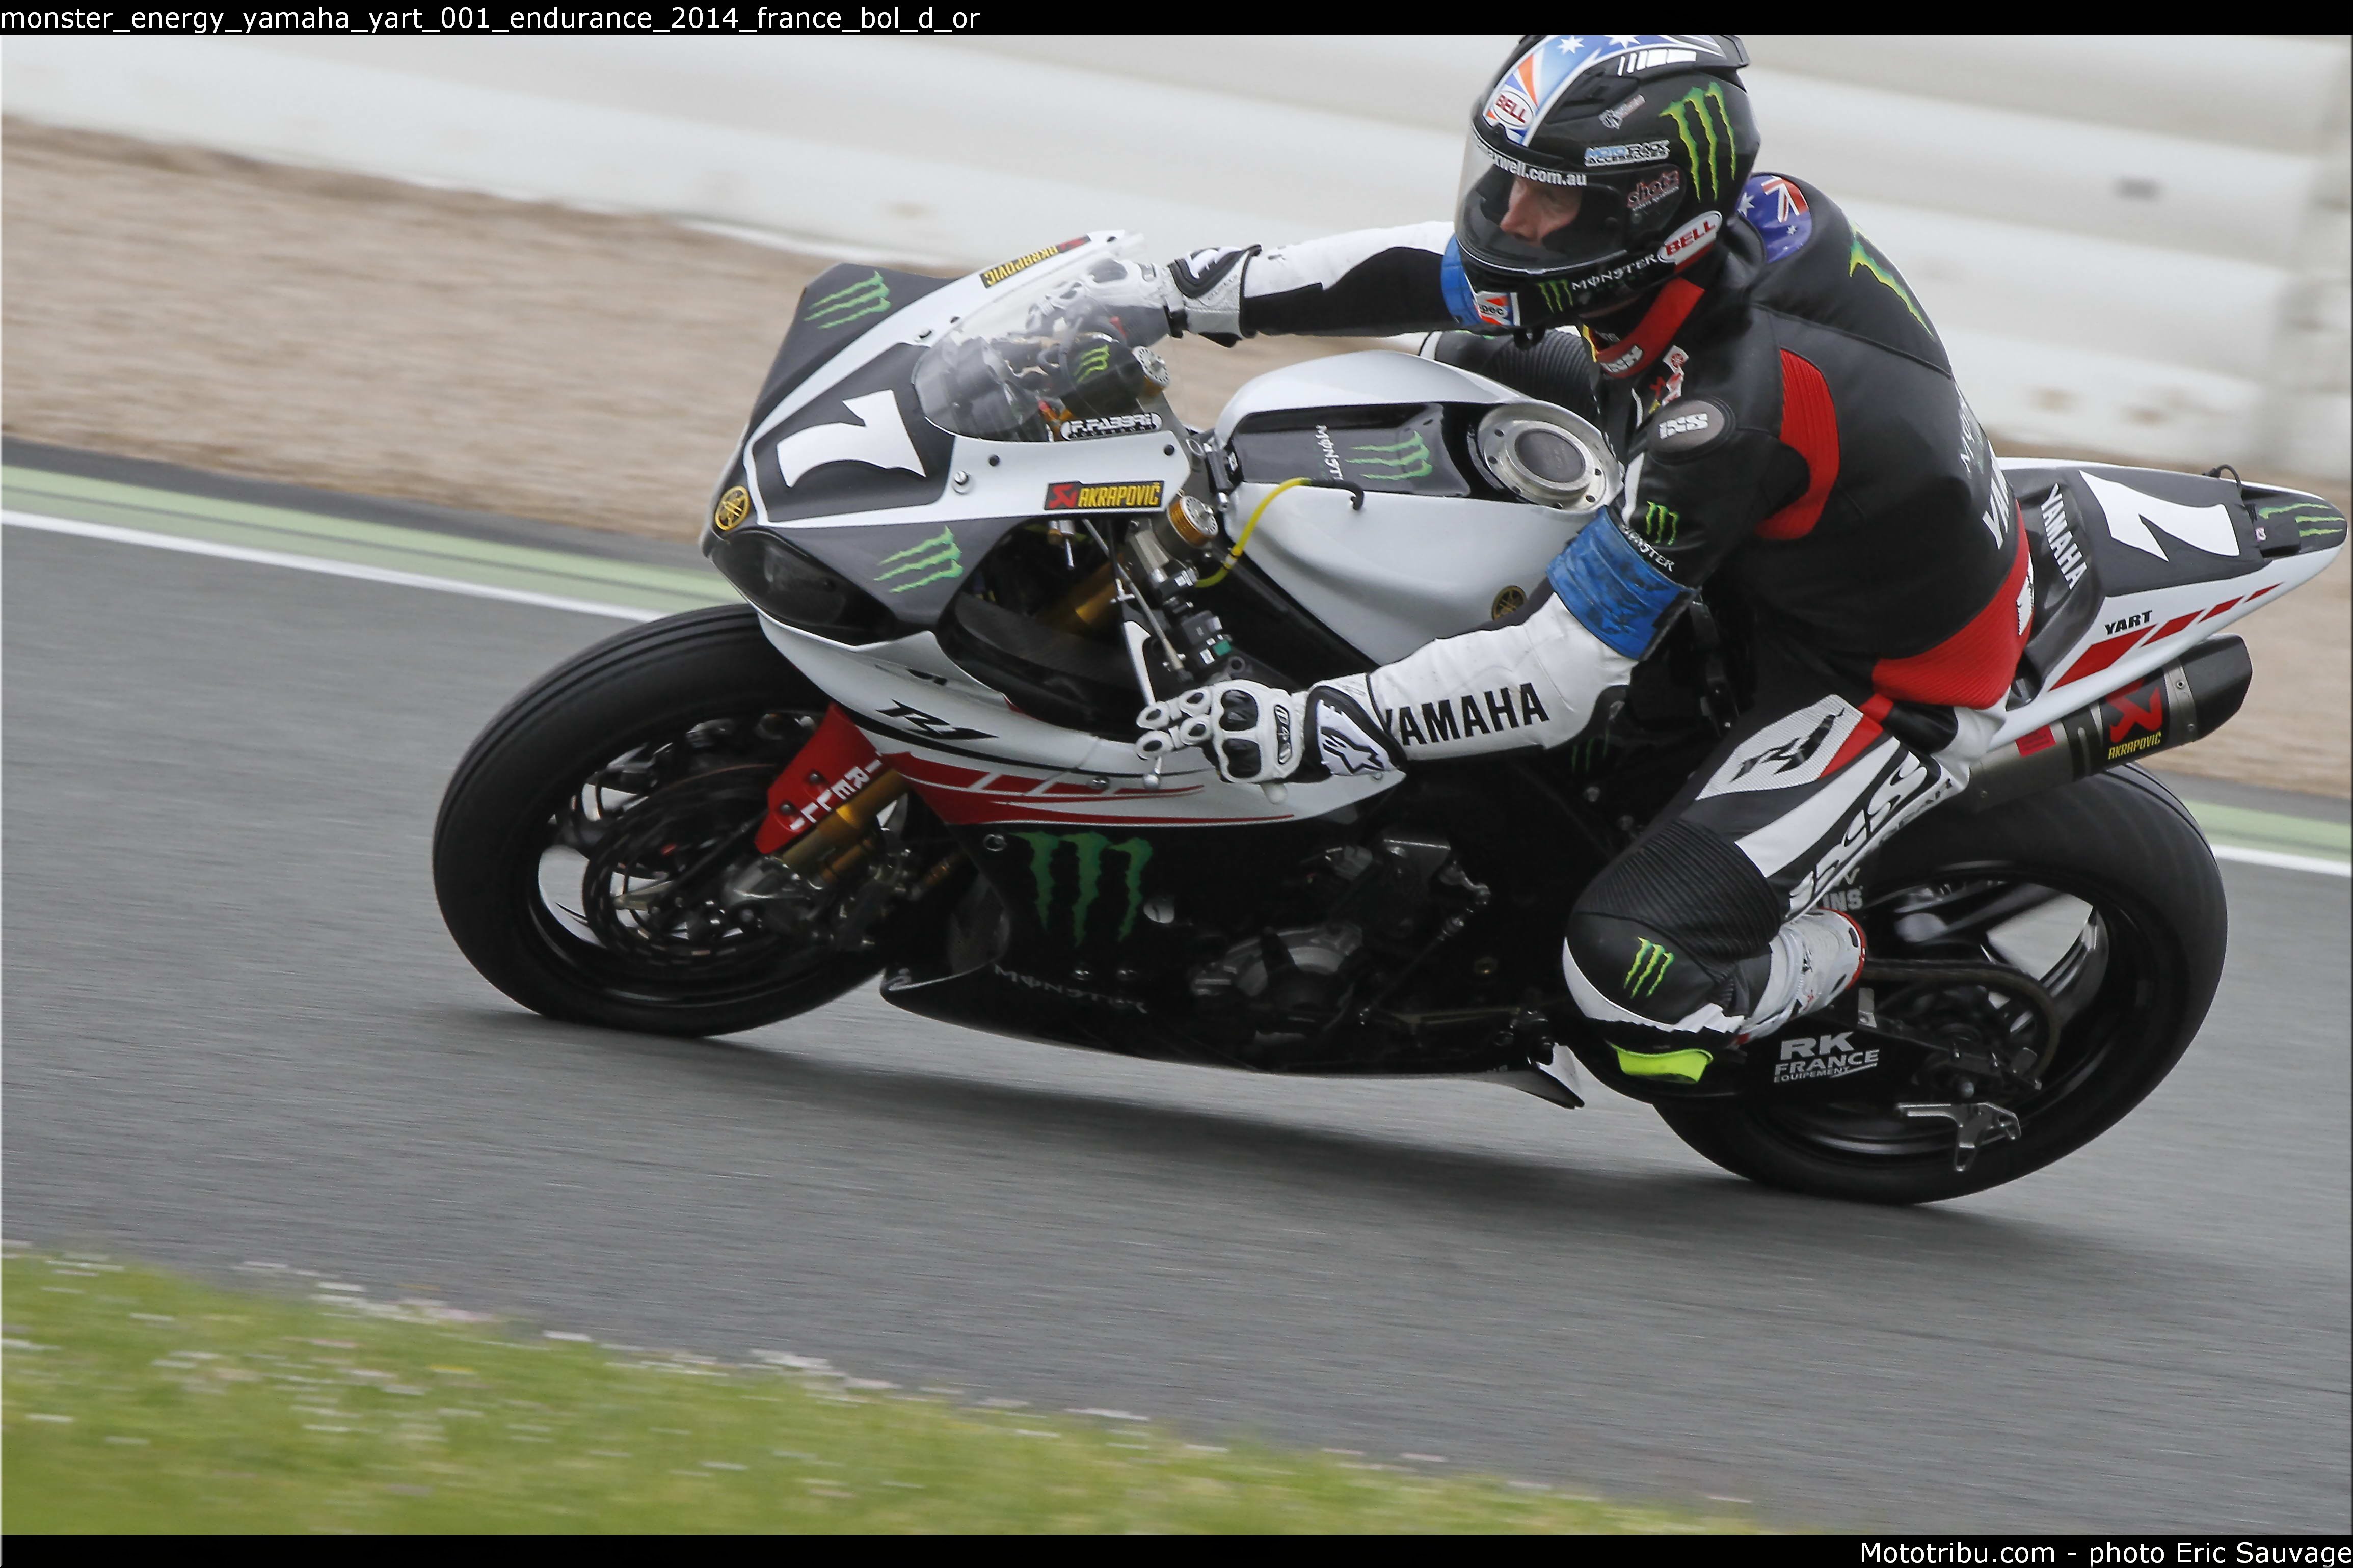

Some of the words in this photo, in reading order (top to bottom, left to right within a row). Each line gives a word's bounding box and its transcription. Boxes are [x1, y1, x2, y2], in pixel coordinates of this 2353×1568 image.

[1495, 94, 1526, 124] BELL
[1665, 219, 1716, 256] BELL
[1571, 254, 1657, 291] MONSTER
[777, 389, 926, 488] 7
[2079, 470, 2240, 562] 7
[2041, 483, 2088, 589] YAMAHA
[2104, 610, 2153, 635] YART
[790, 750, 883, 831] IRELLI
[1774, 1049, 1879, 1075] FRANCE
[1780, 1031, 1854, 1060] RK
